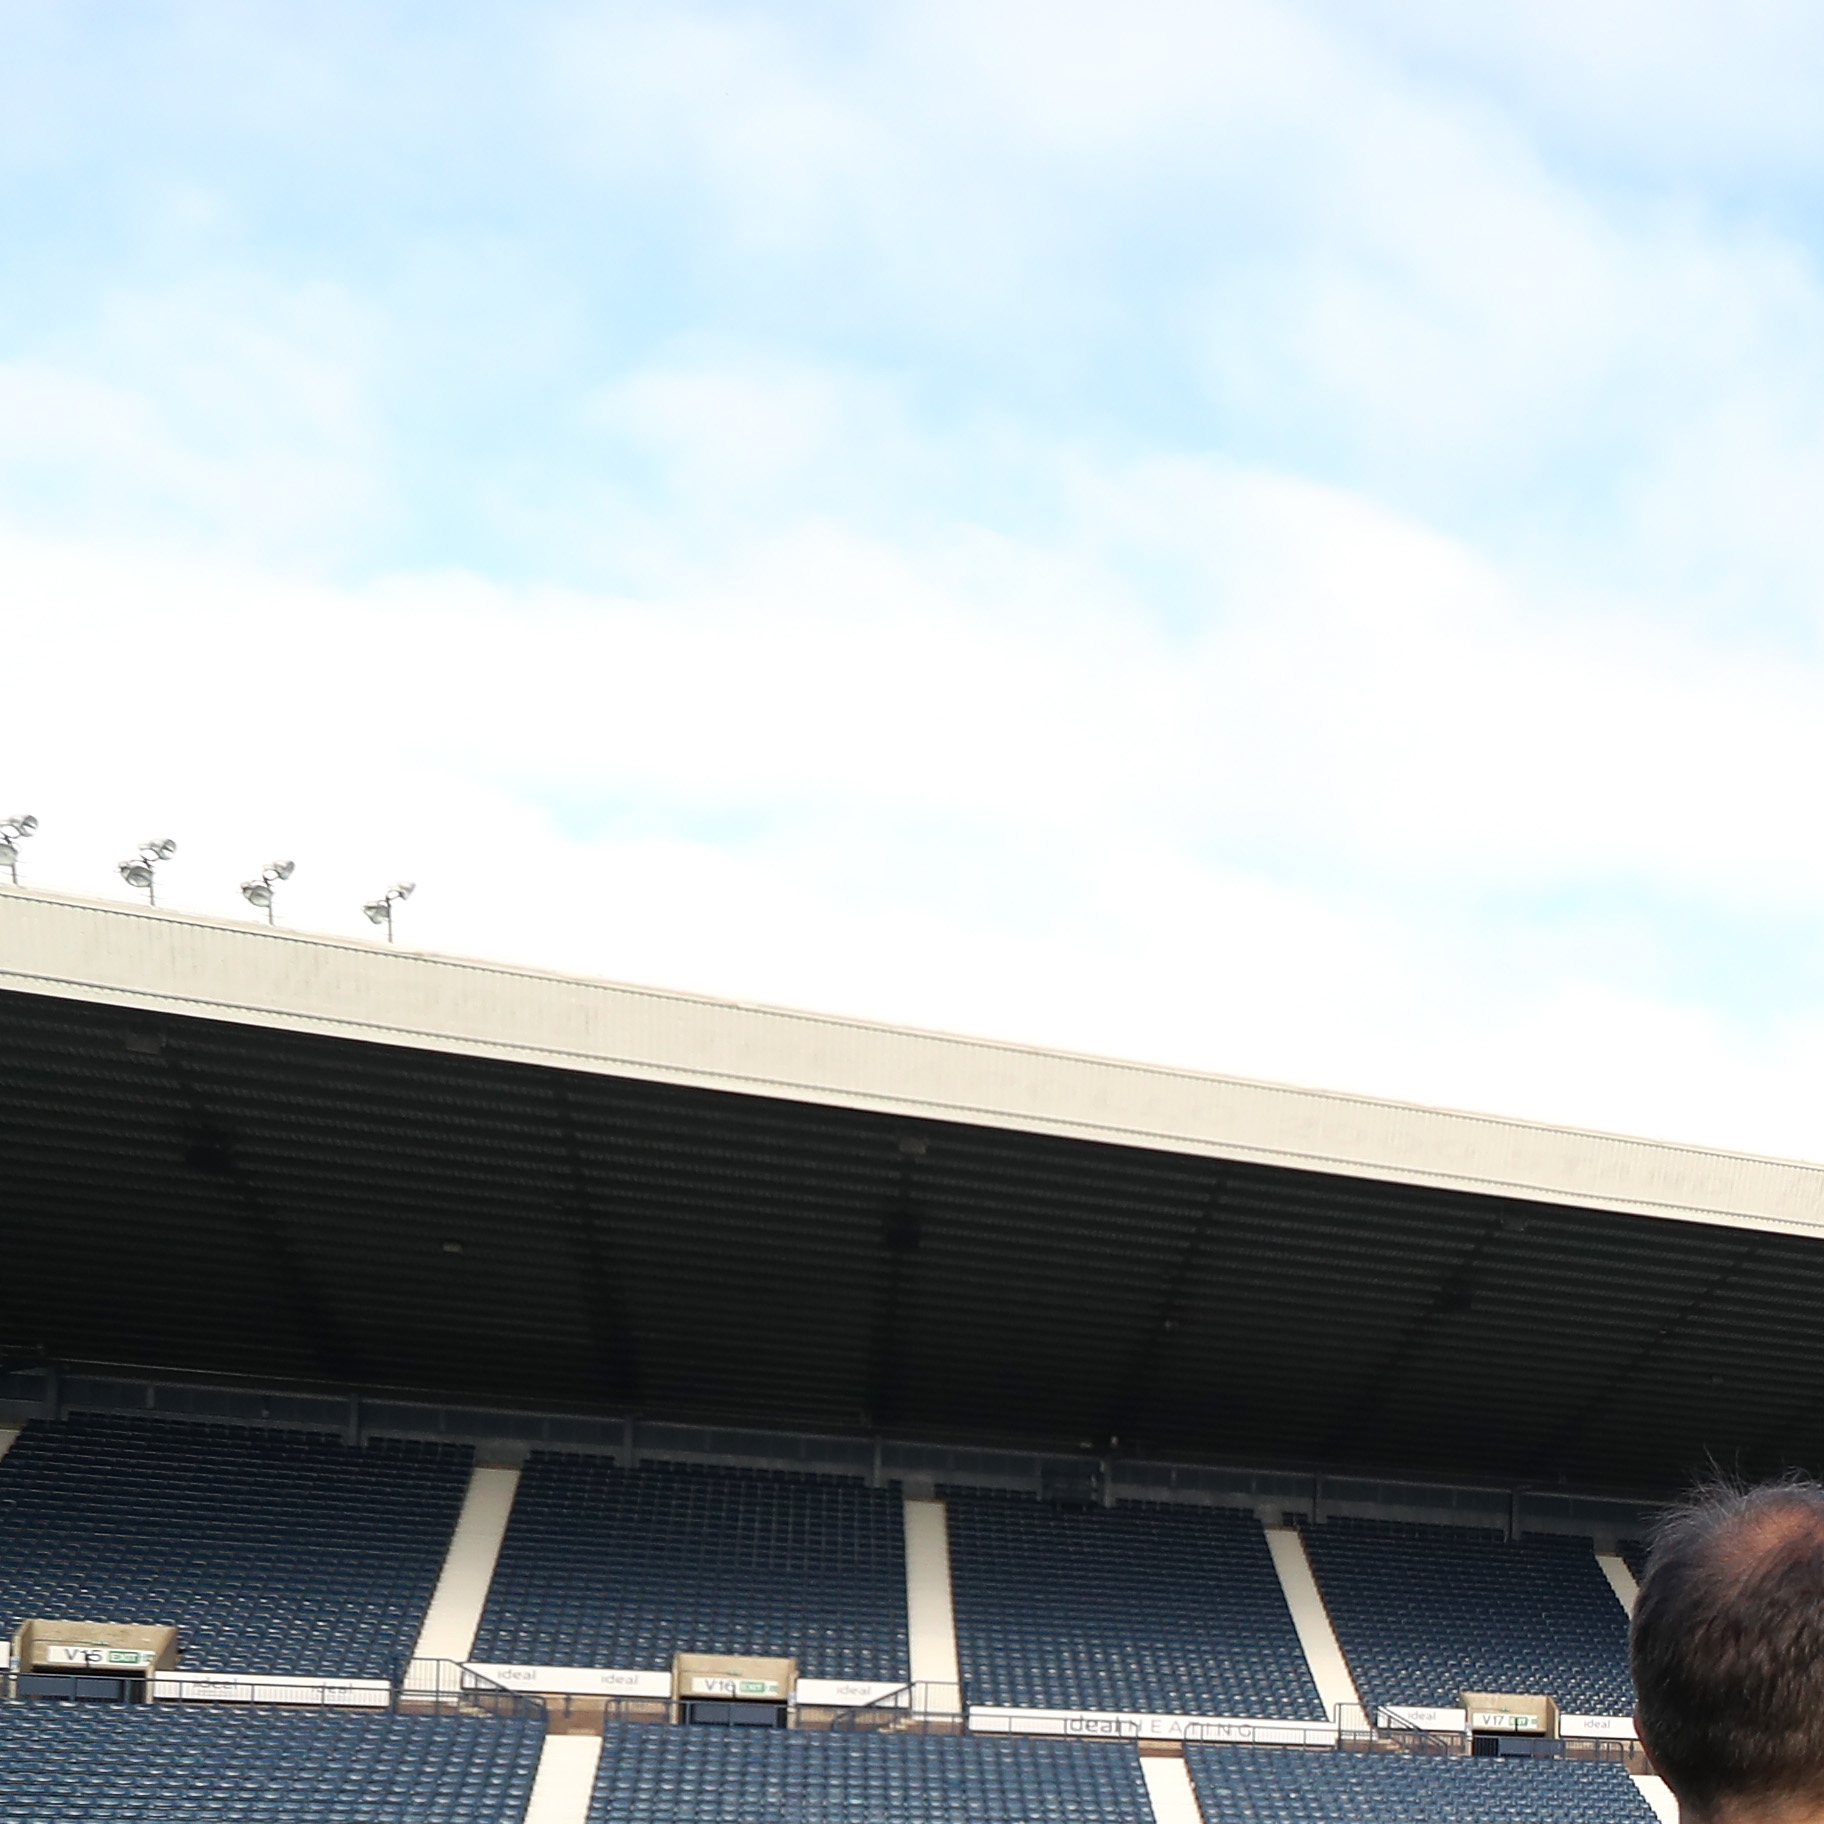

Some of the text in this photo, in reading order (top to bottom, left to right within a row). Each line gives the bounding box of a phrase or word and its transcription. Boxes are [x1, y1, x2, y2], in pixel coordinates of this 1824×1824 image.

[497, 1669, 537, 1682] ideal
[601, 1675, 640, 1687] ideal
[836, 1685, 872, 1697] ideal
[1408, 1711, 1437, 1721] ideal
[1483, 1714, 1505, 1726] V17
[1583, 1718, 1612, 1729] ideal
